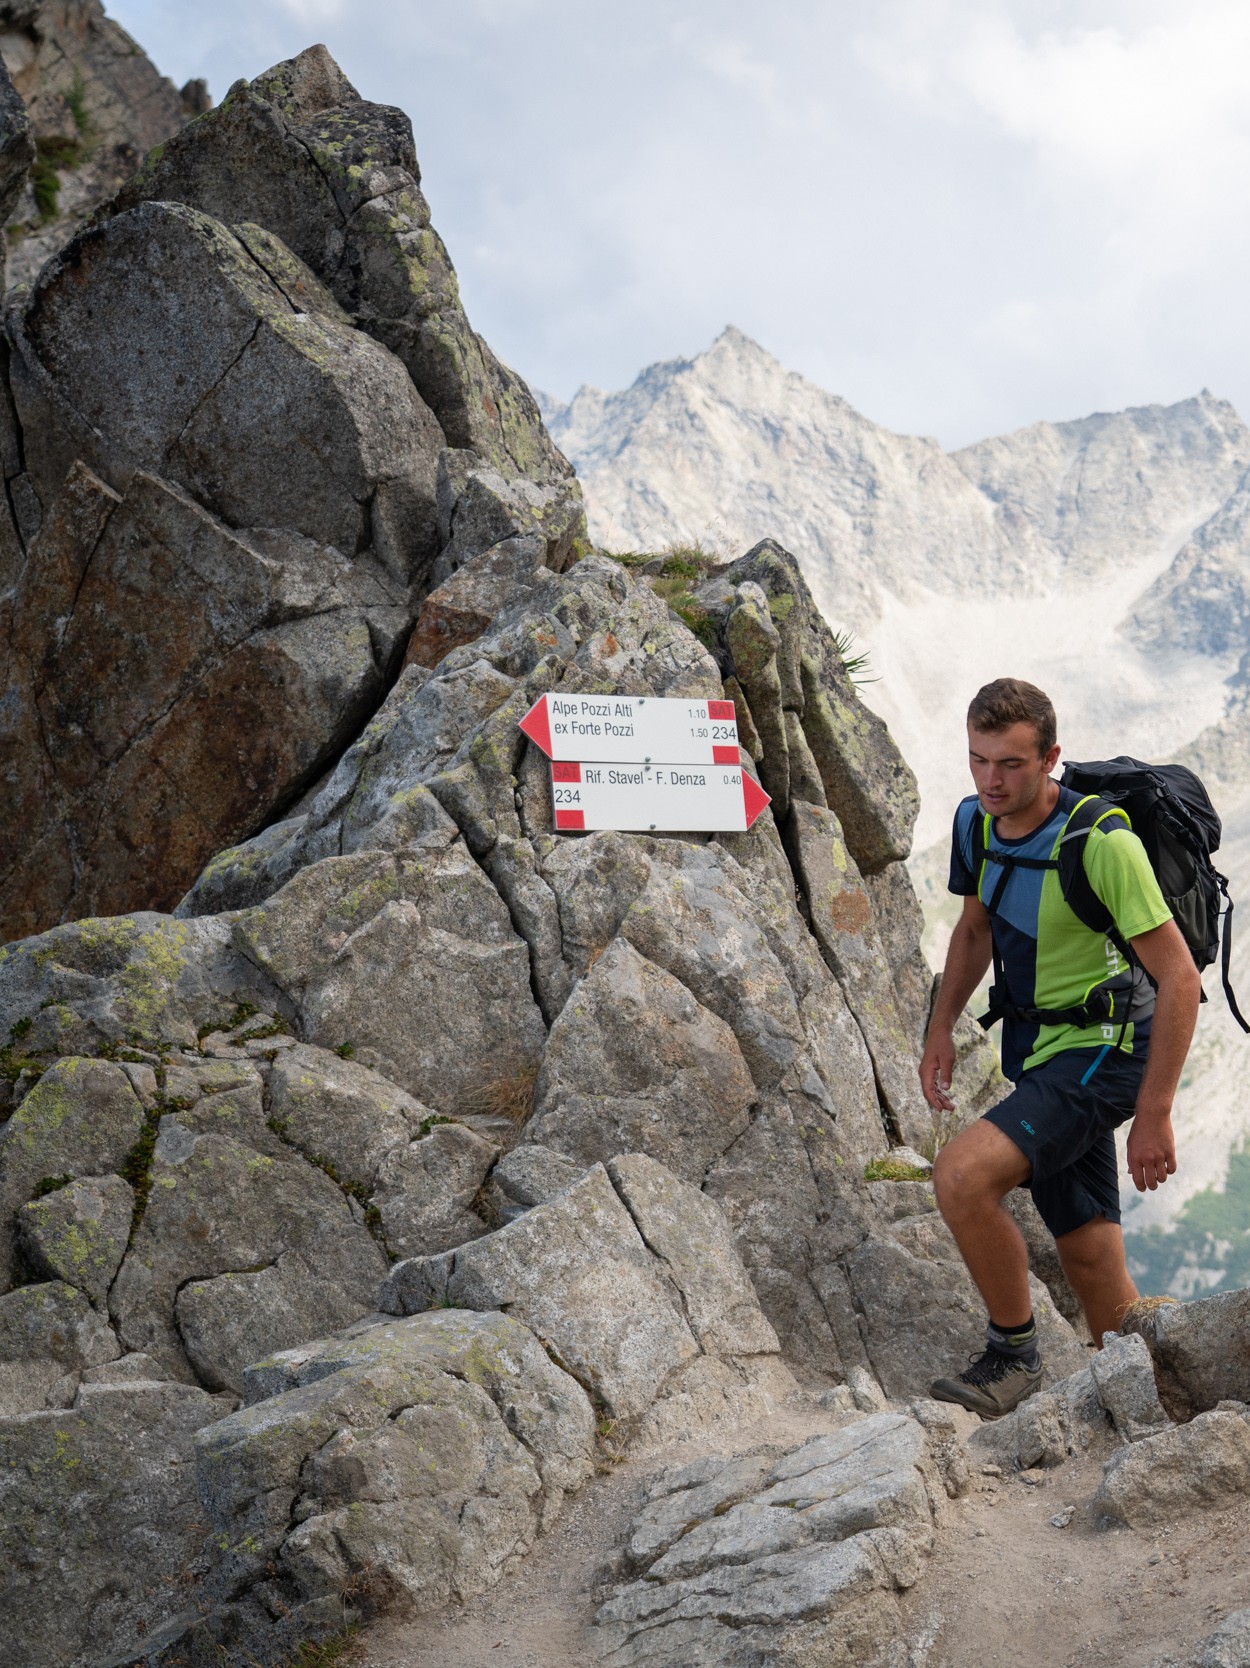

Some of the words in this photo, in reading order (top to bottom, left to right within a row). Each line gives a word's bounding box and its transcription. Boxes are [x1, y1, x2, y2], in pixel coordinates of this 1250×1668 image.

[552, 700, 578, 717] Alpe
[581, 701, 611, 717] Pozzi
[614, 703, 633, 718] Alti
[688, 708, 707, 719] 1.10
[710, 703, 733, 717] SAT
[554, 722, 568, 735] ex
[571, 721, 601, 736] Forte
[604, 722, 634, 737] Pozzi
[690, 727, 709, 738] 1.50
[712, 725, 737, 740] 234
[585, 769, 605, 784] Rif.
[608, 770, 644, 785] Stavel
[656, 771, 667, 785] F.
[671, 771, 706, 786] Denza
[723, 774, 742, 785] 0.40
[555, 789, 581, 804] 234
